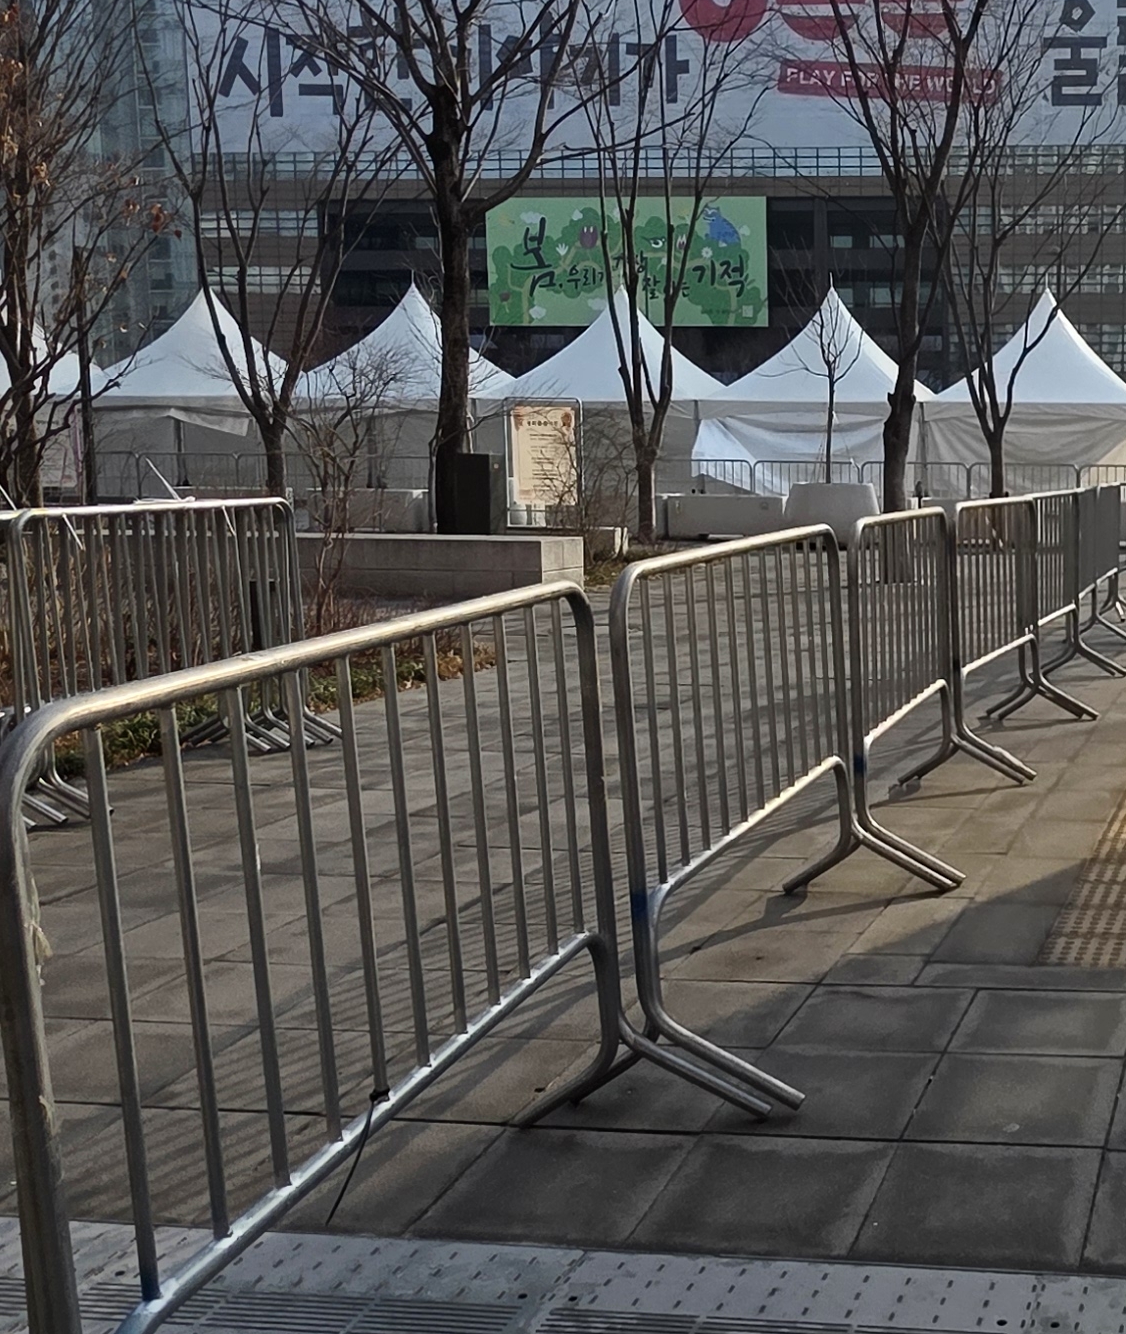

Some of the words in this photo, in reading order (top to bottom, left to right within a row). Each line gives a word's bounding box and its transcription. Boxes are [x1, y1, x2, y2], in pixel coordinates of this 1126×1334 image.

[786, 67, 836, 87] PLAY
[884, 72, 922, 92] HE
[926, 74, 999, 95] WOLD
[692, 253, 746, 298] 기적
